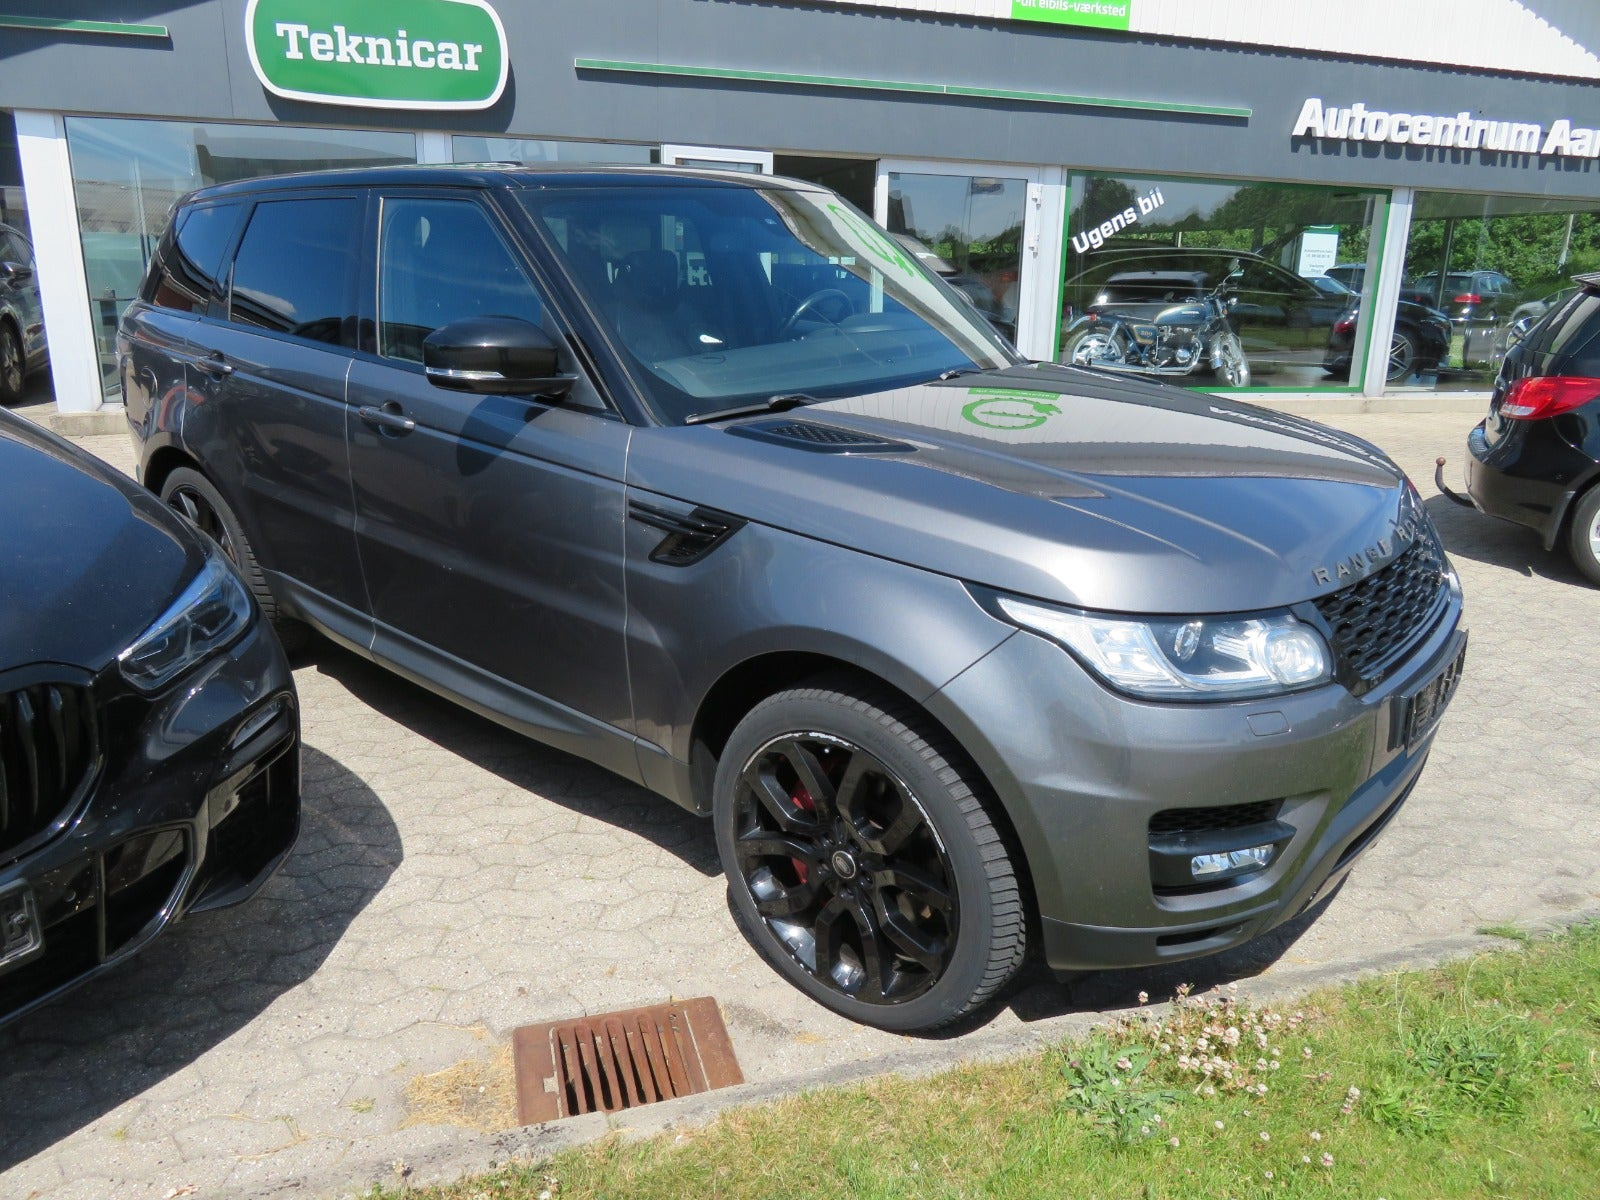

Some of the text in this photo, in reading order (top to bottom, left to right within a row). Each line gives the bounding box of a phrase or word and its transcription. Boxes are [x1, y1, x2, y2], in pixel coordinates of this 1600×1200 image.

[275, 23, 482, 71] Teknicar
[1292, 98, 1541, 153] Autocentrum
[1072, 186, 1165, 254] Ugens bil
